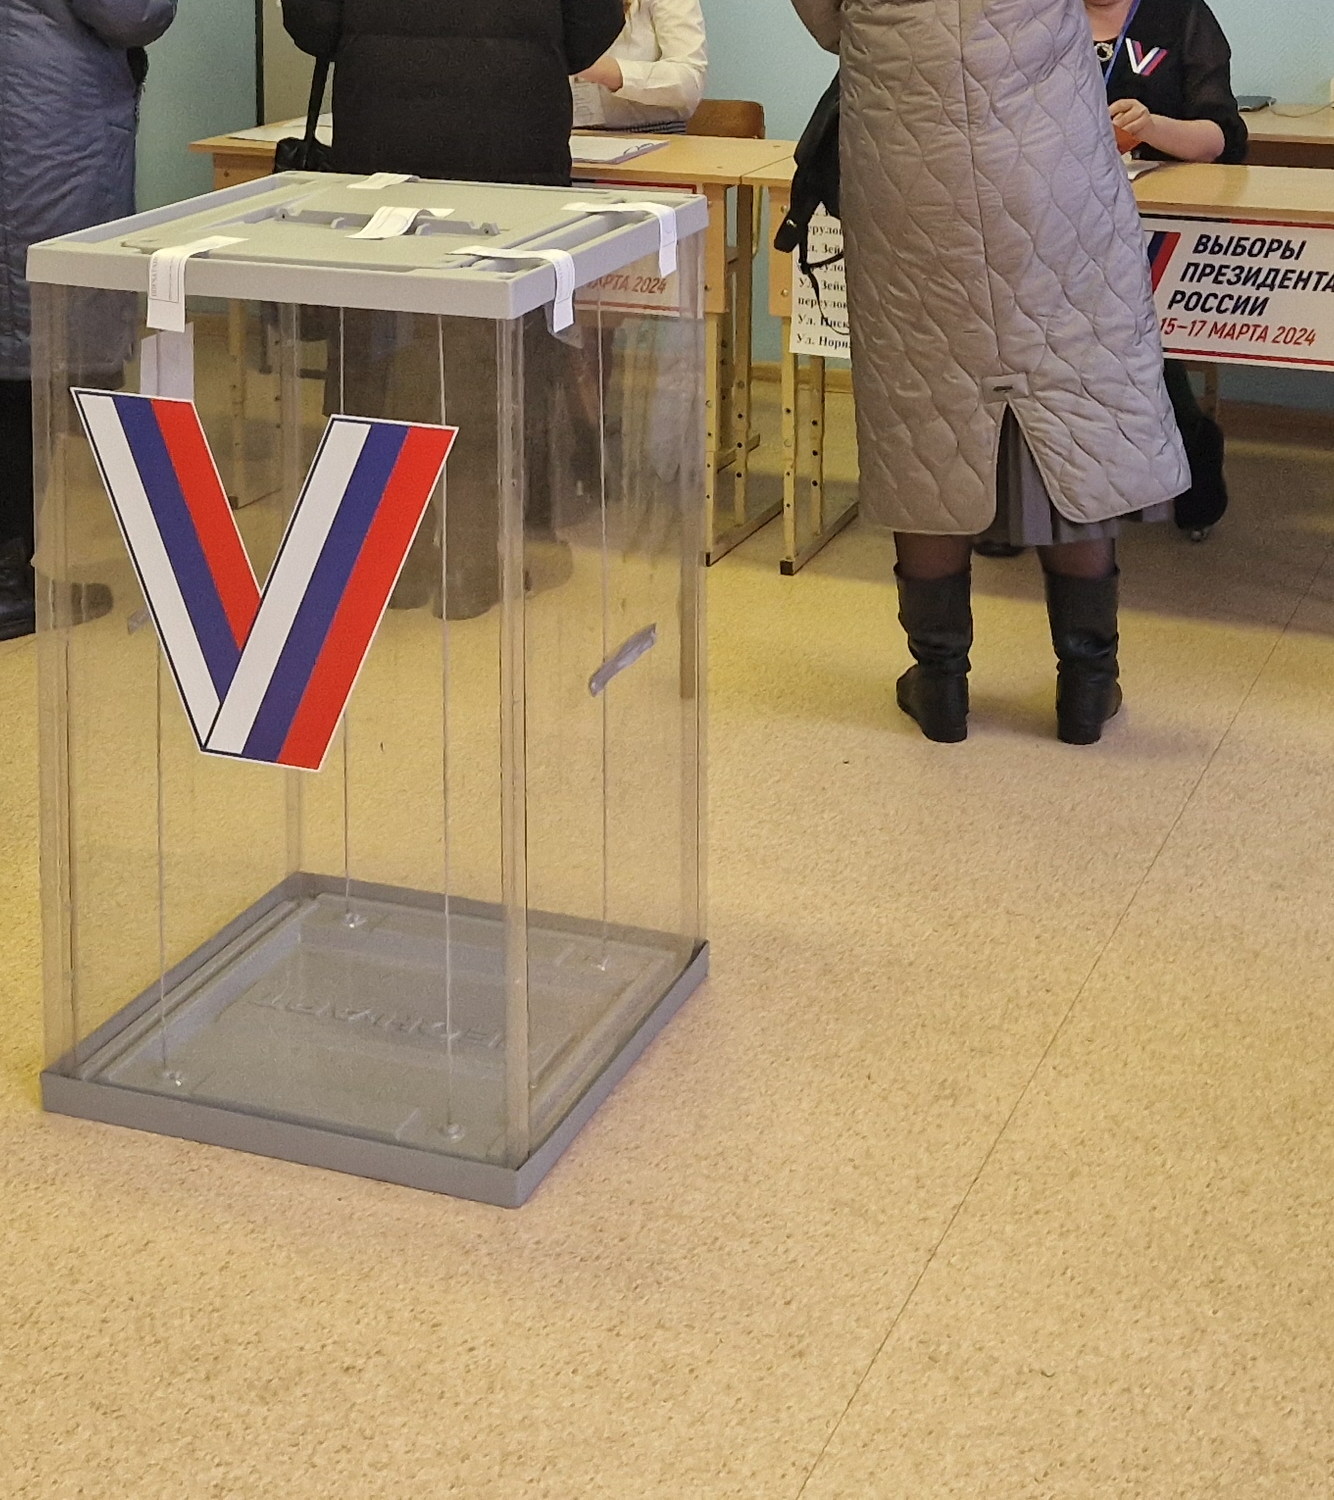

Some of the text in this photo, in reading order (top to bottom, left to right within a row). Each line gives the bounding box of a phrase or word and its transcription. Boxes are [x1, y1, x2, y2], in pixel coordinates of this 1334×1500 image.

[1192, 234, 1307, 261] ВЫБОРЫ
[632, 276, 667, 294] 2024
[1167, 290, 1270, 316] РОССИИ
[819, 336, 850, 350] Нори
[1207, 320, 1269, 343] МАРТА
[1271, 326, 1317, 346] 2024
